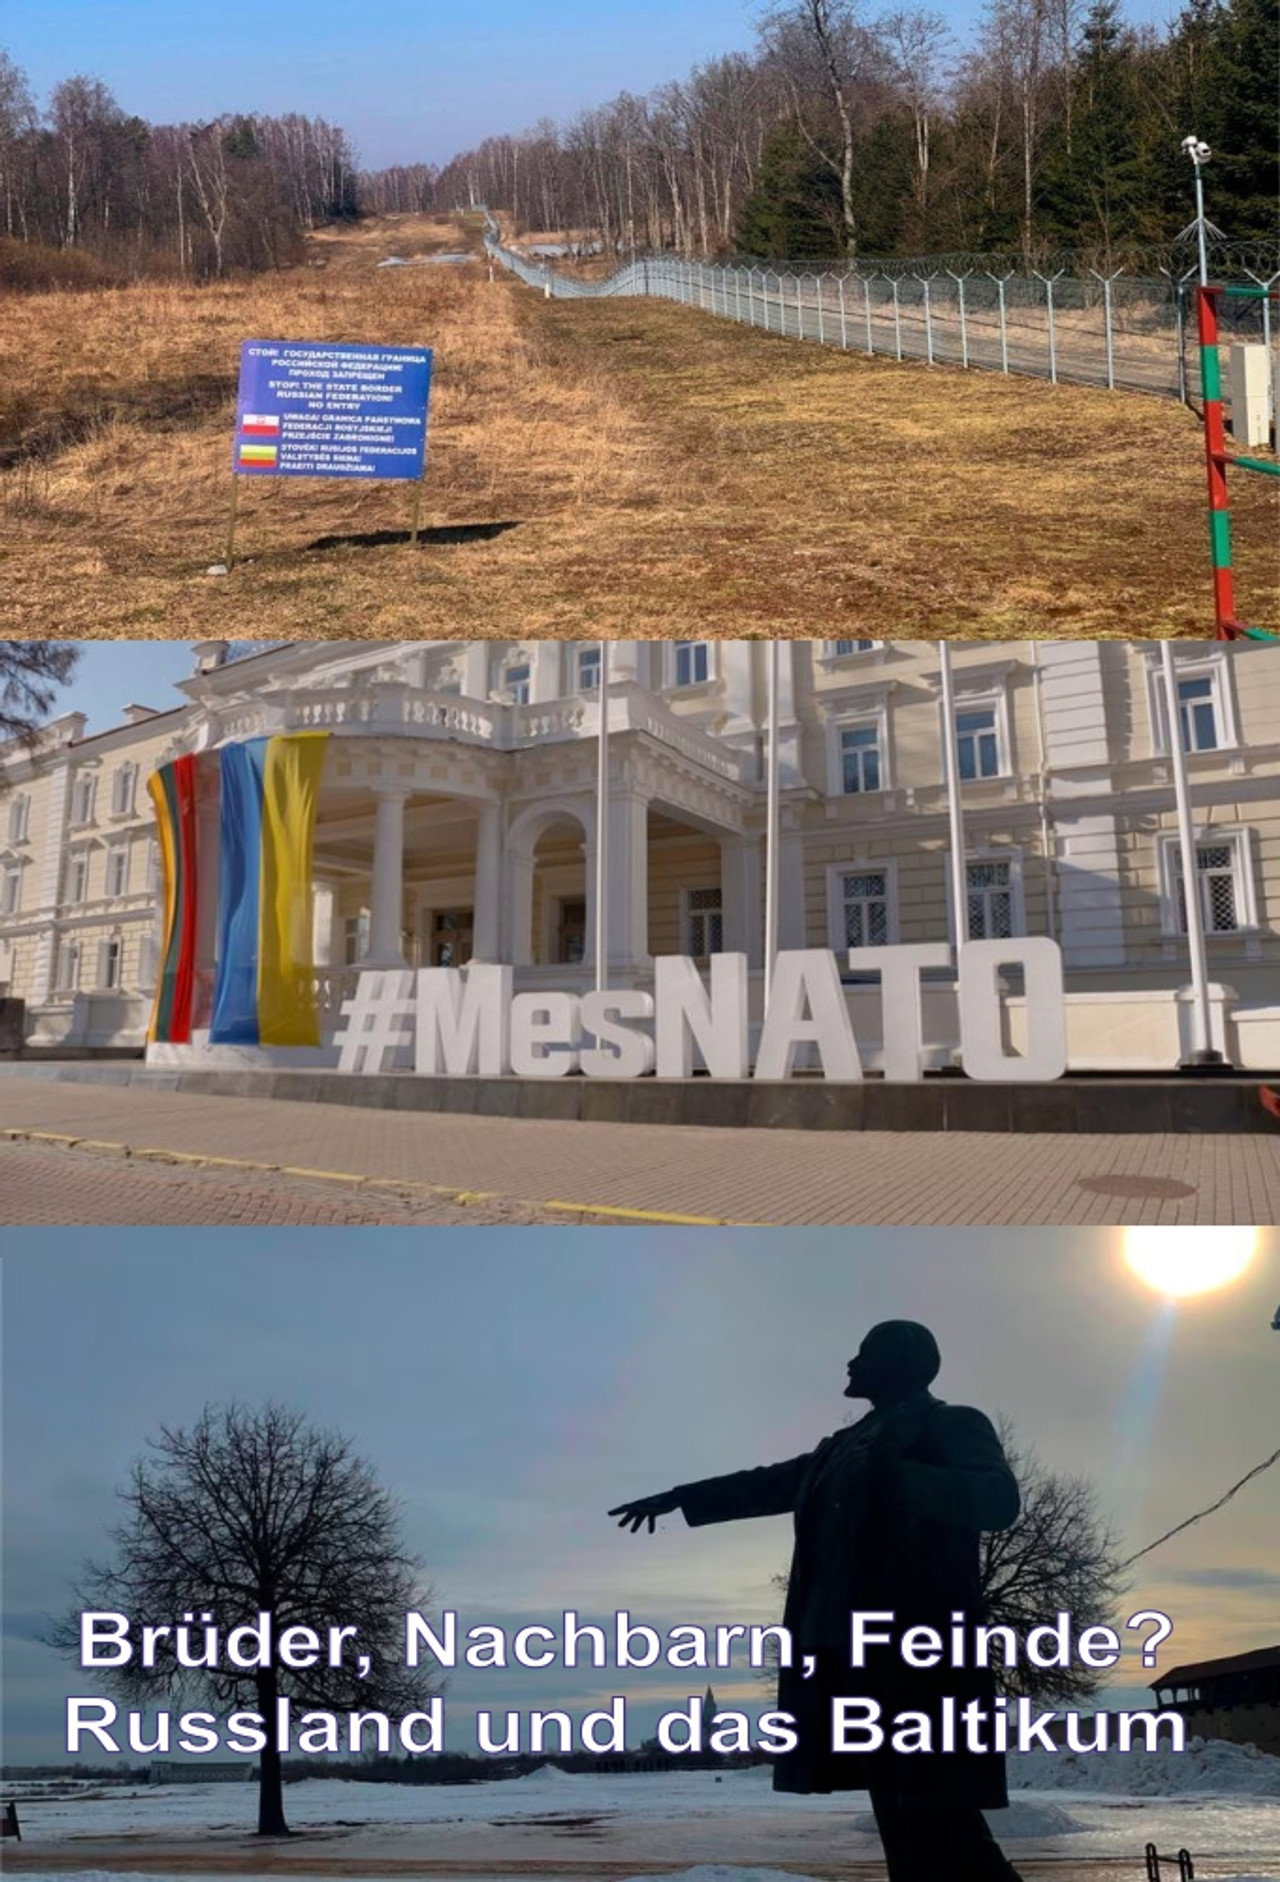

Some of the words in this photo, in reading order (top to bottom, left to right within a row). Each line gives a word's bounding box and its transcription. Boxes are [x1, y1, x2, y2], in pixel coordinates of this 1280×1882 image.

[284, 350, 380, 361] ГОСУДАРСТВЕННАЯ
[381, 354, 426, 364] ГРАНИЦА
[271, 359, 338, 368] РОССИЙСКОЙ
[288, 369, 330, 378] ПРОХОД
[302, 382, 322, 390] THE
[326, 384, 358, 392] STATE
[361, 384, 402, 394] BORDER
[276, 390, 323, 398] RUSSIAN
[326, 402, 360, 410] ENTRY
[322, 414, 362, 422] GRANICA
[332, 937, 1067, 1082] #MesNATO
